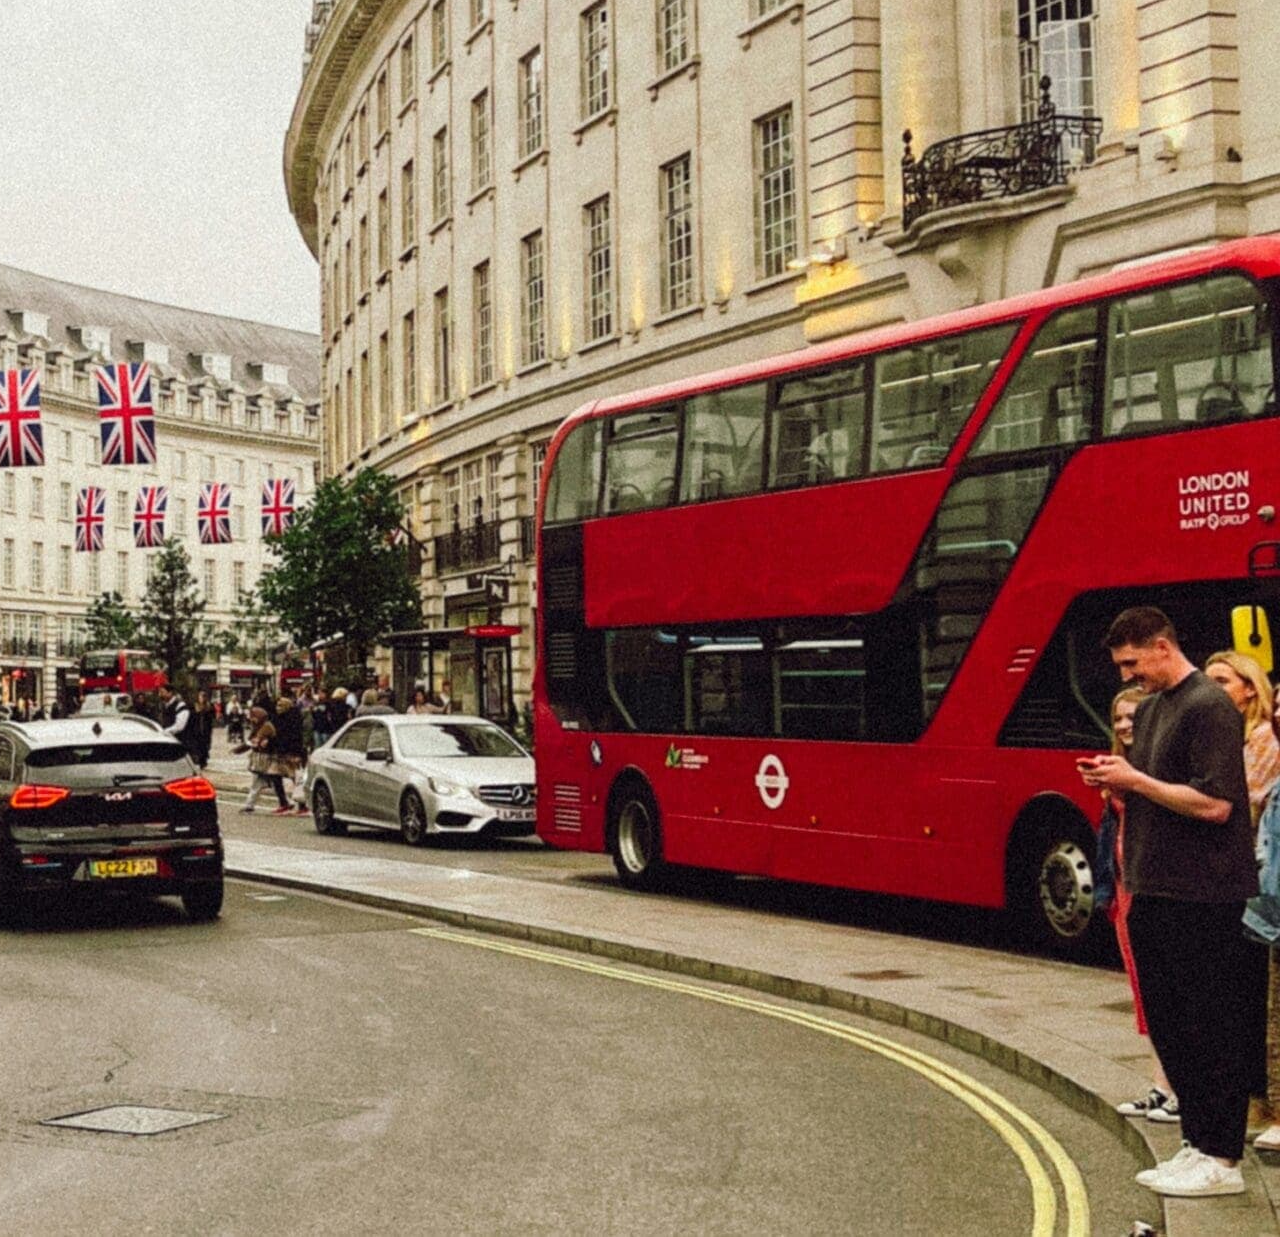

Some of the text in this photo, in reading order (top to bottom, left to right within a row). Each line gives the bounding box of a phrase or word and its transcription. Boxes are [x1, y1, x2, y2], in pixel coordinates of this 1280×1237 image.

[1178, 470, 1249, 494] LONDON
[1179, 492, 1250, 515] UNITED
[1180, 517, 1206, 530] RATP
